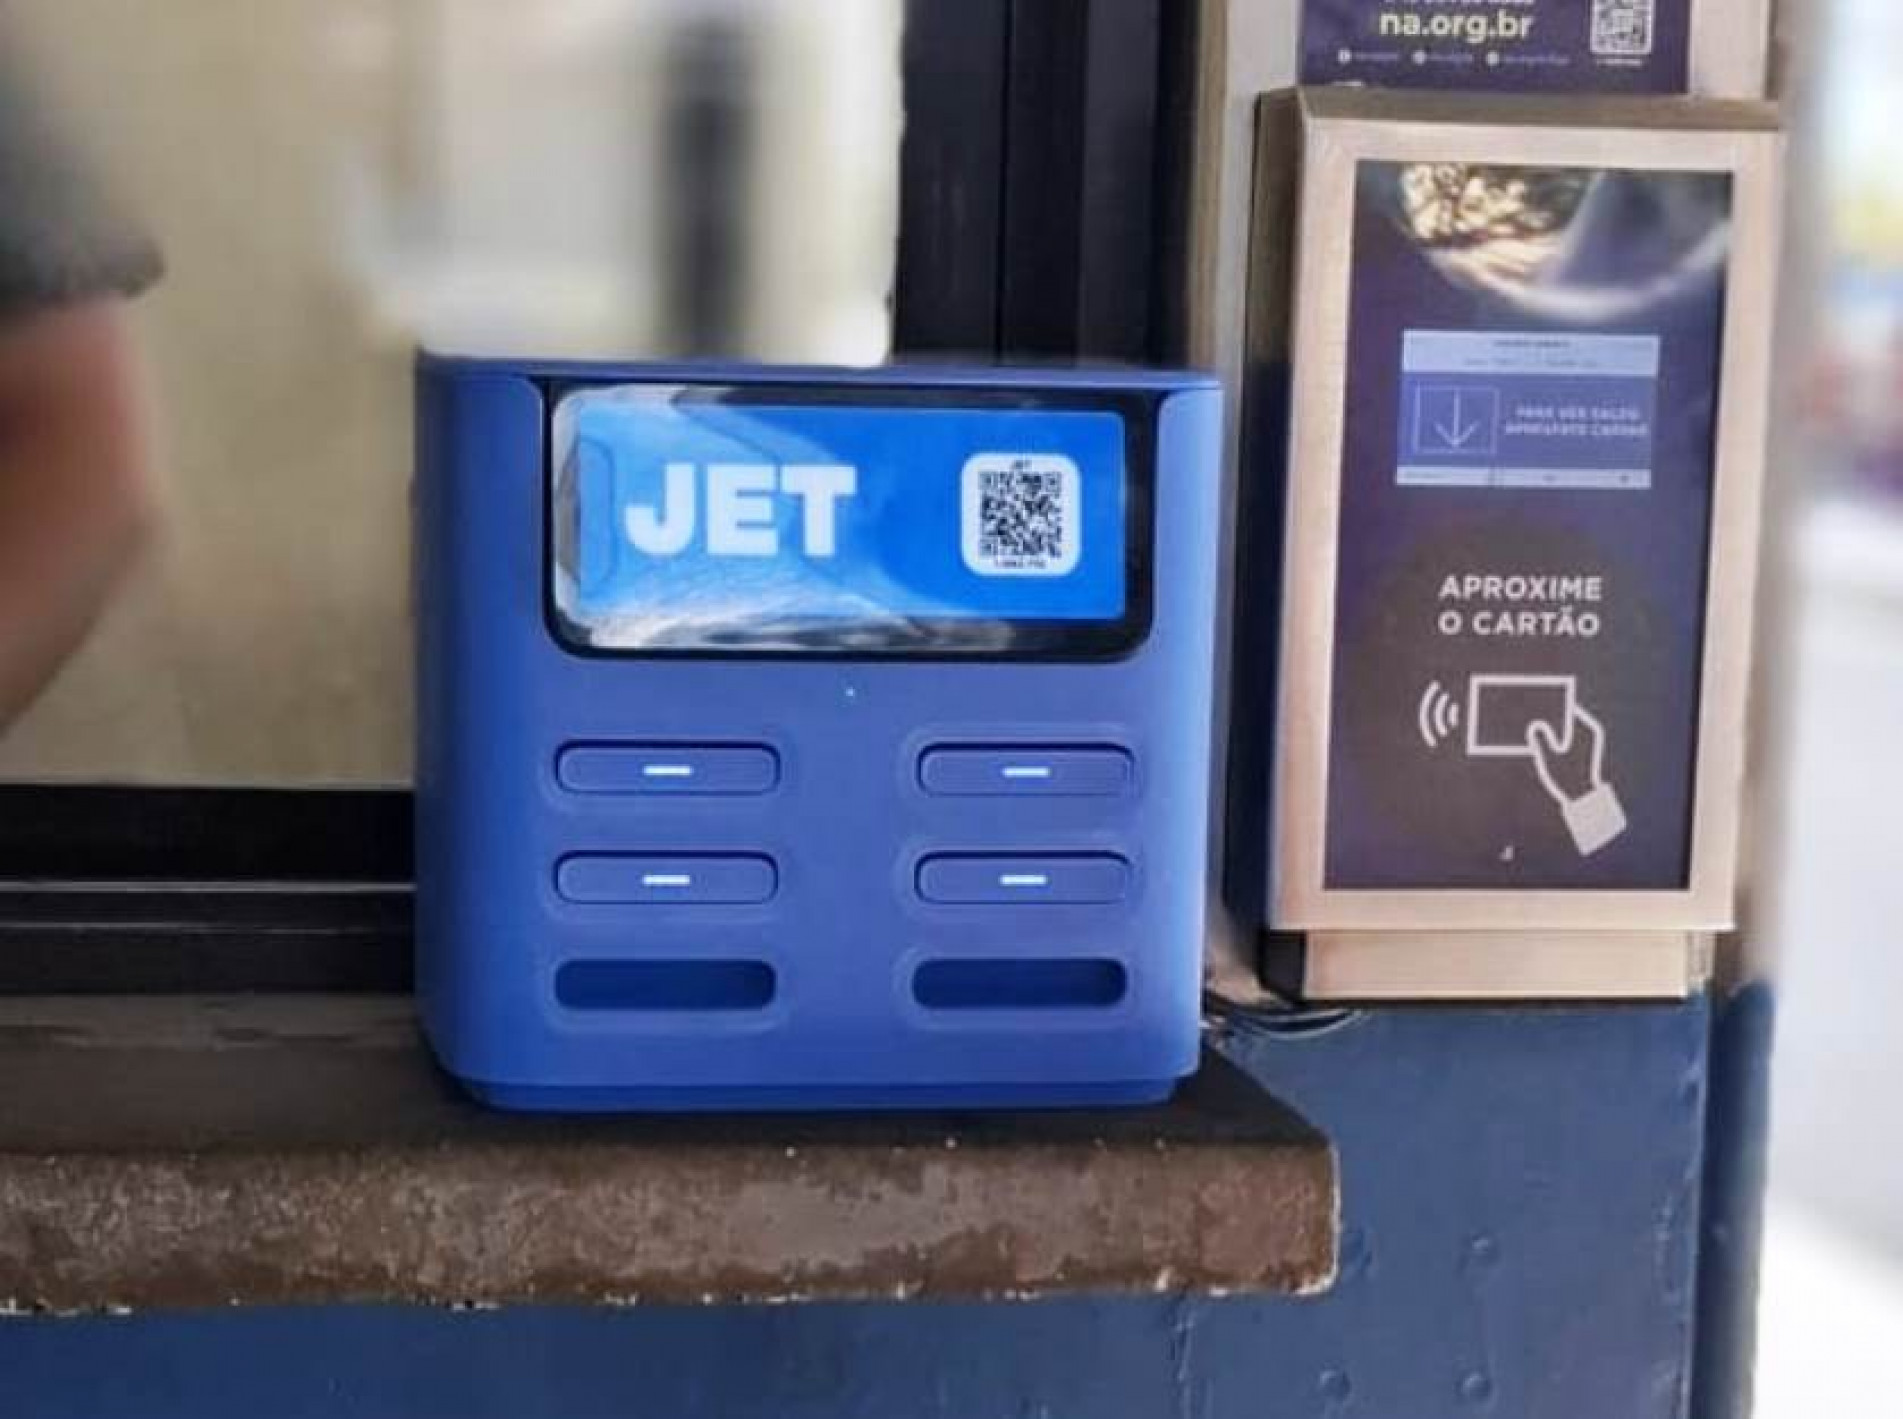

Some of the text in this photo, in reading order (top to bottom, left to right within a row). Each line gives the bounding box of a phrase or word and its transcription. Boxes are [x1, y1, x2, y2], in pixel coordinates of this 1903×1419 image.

[1379, 9, 1535, 43] na.org.br
[624, 463, 857, 556] JET
[1440, 576, 1602, 600] APROXIME
[1439, 607, 1601, 636] O CARTÃO
